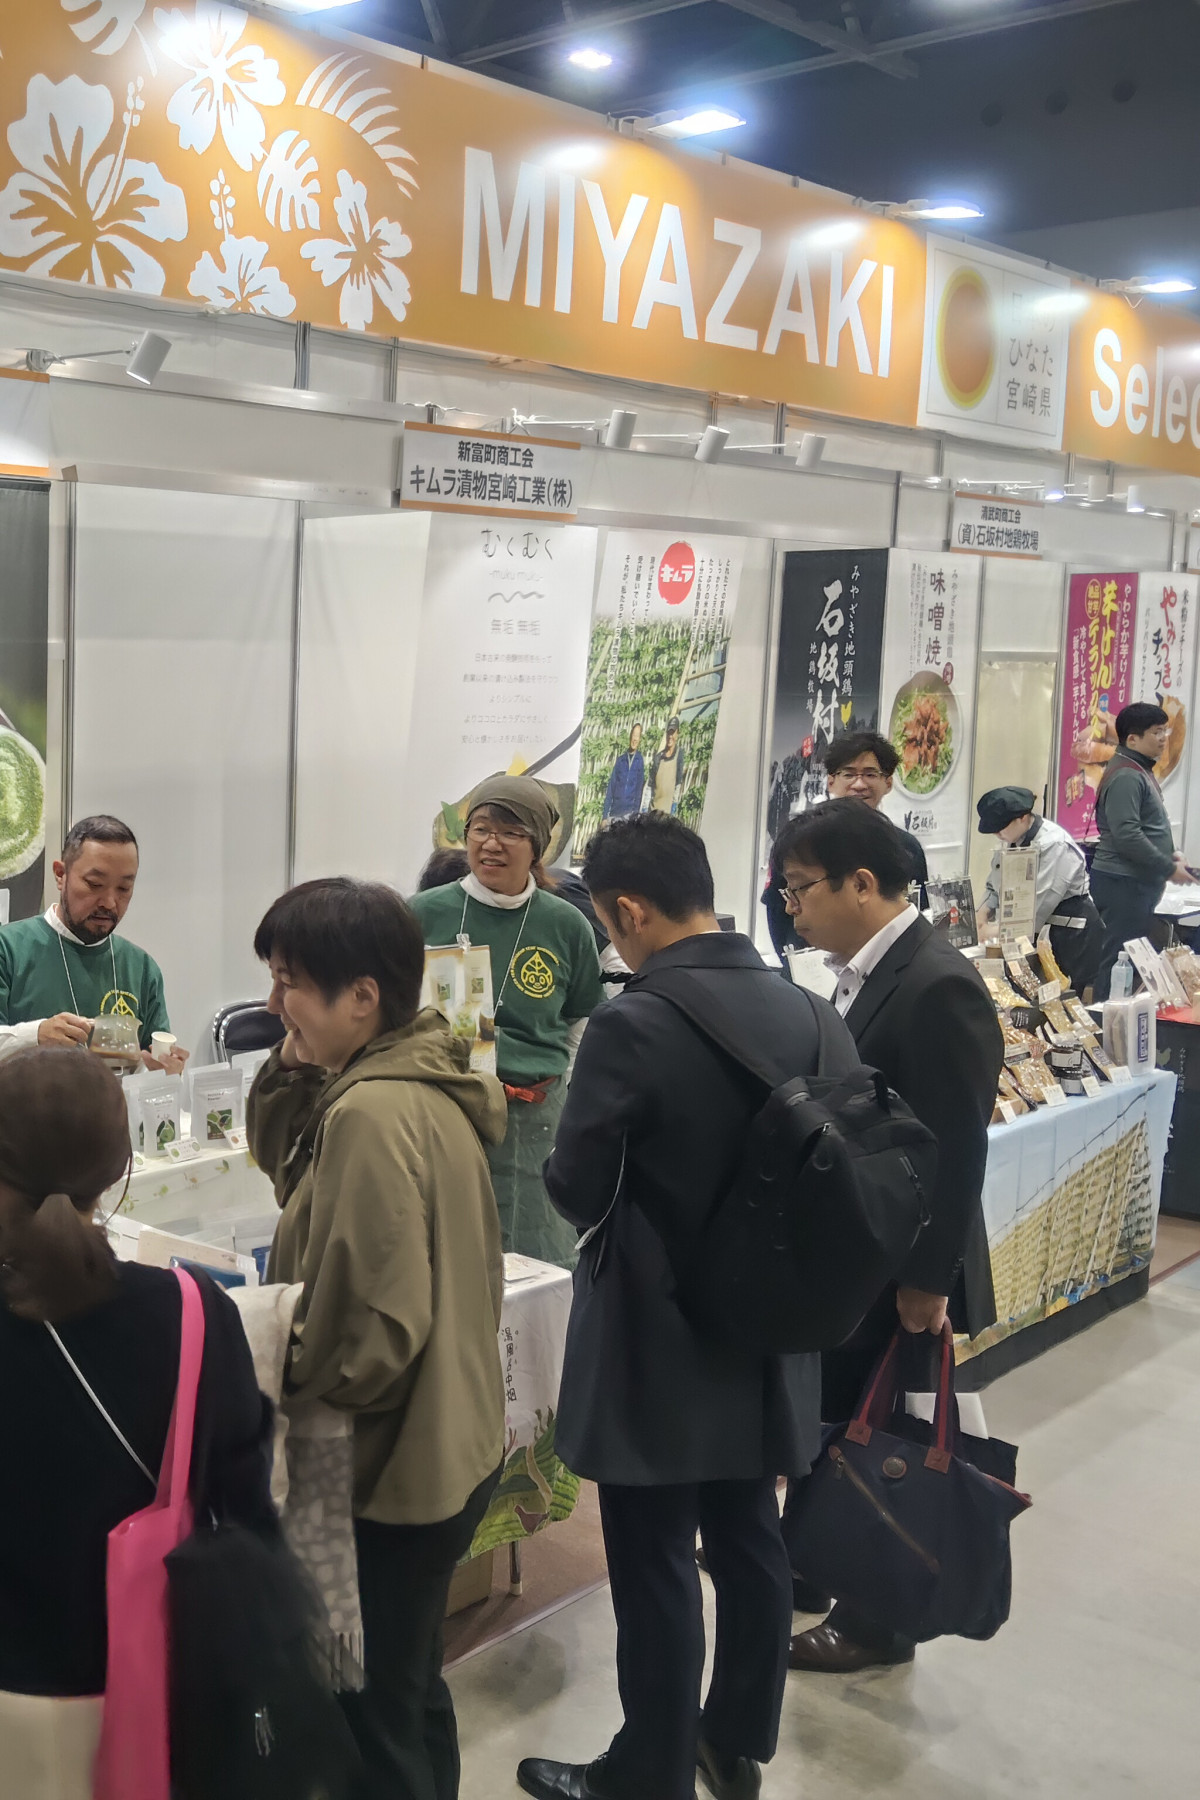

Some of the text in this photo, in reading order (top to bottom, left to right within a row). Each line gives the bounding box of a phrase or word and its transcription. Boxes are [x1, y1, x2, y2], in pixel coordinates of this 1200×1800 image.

[459, 146, 894, 379] MIYAZAKI
[1009, 337, 1054, 378] ひなた
[1006, 377, 1052, 418] 宮崎県
[457, 440, 535, 469] 新富町商工会
[409, 464, 574, 509] キムラ漬物宮崎工業(株)
[980, 505, 1022, 525] 清武町商工会
[480, 527, 554, 561] むくむく
[660, 563, 694, 583] キムラ
[841, 563, 861, 697] みやざき地頭鶏
[924, 567, 946, 666] 味噌焼
[811, 578, 846, 746] 石坂村
[1118, 583, 1132, 704] やわらか芋けんぴ
